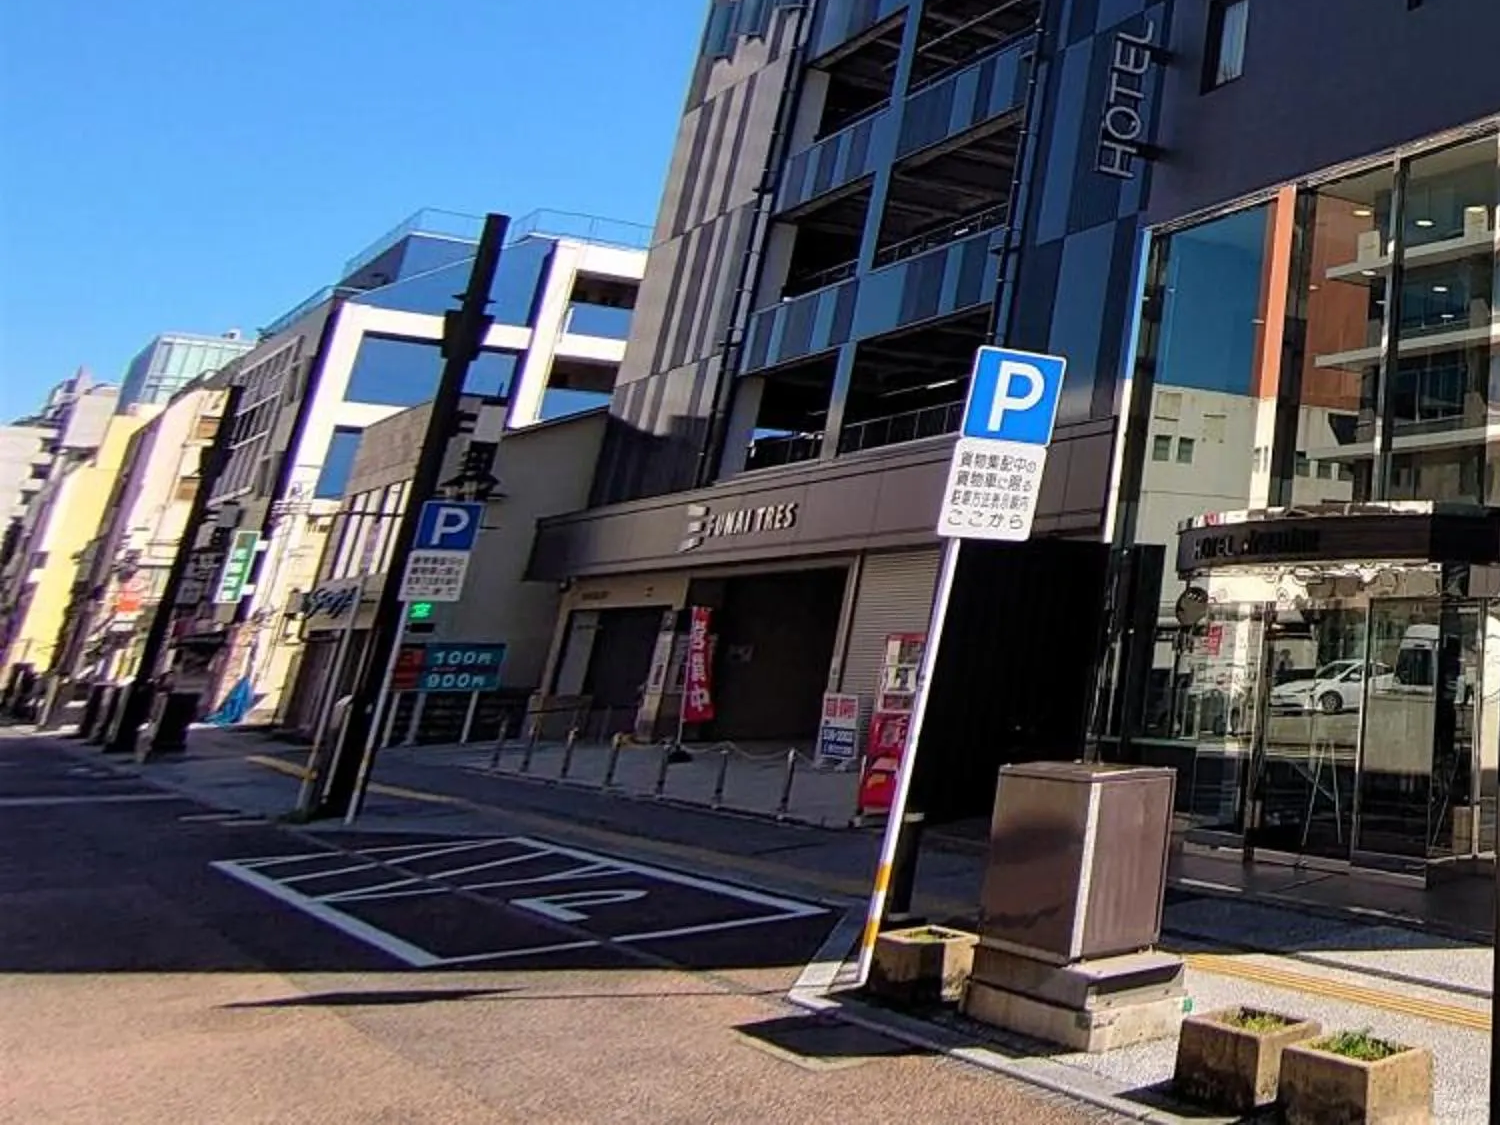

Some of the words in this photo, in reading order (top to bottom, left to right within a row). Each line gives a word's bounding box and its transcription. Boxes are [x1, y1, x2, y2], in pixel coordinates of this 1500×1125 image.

[1096, 20, 1155, 179] HOTEL
[987, 360, 1045, 432] P
[956, 470, 1033, 492] 貨物車に限る
[431, 507, 470, 546] P
[706, 509, 755, 537] FUNAI
[756, 502, 799, 532] TRES
[947, 508, 1024, 530] ここから
